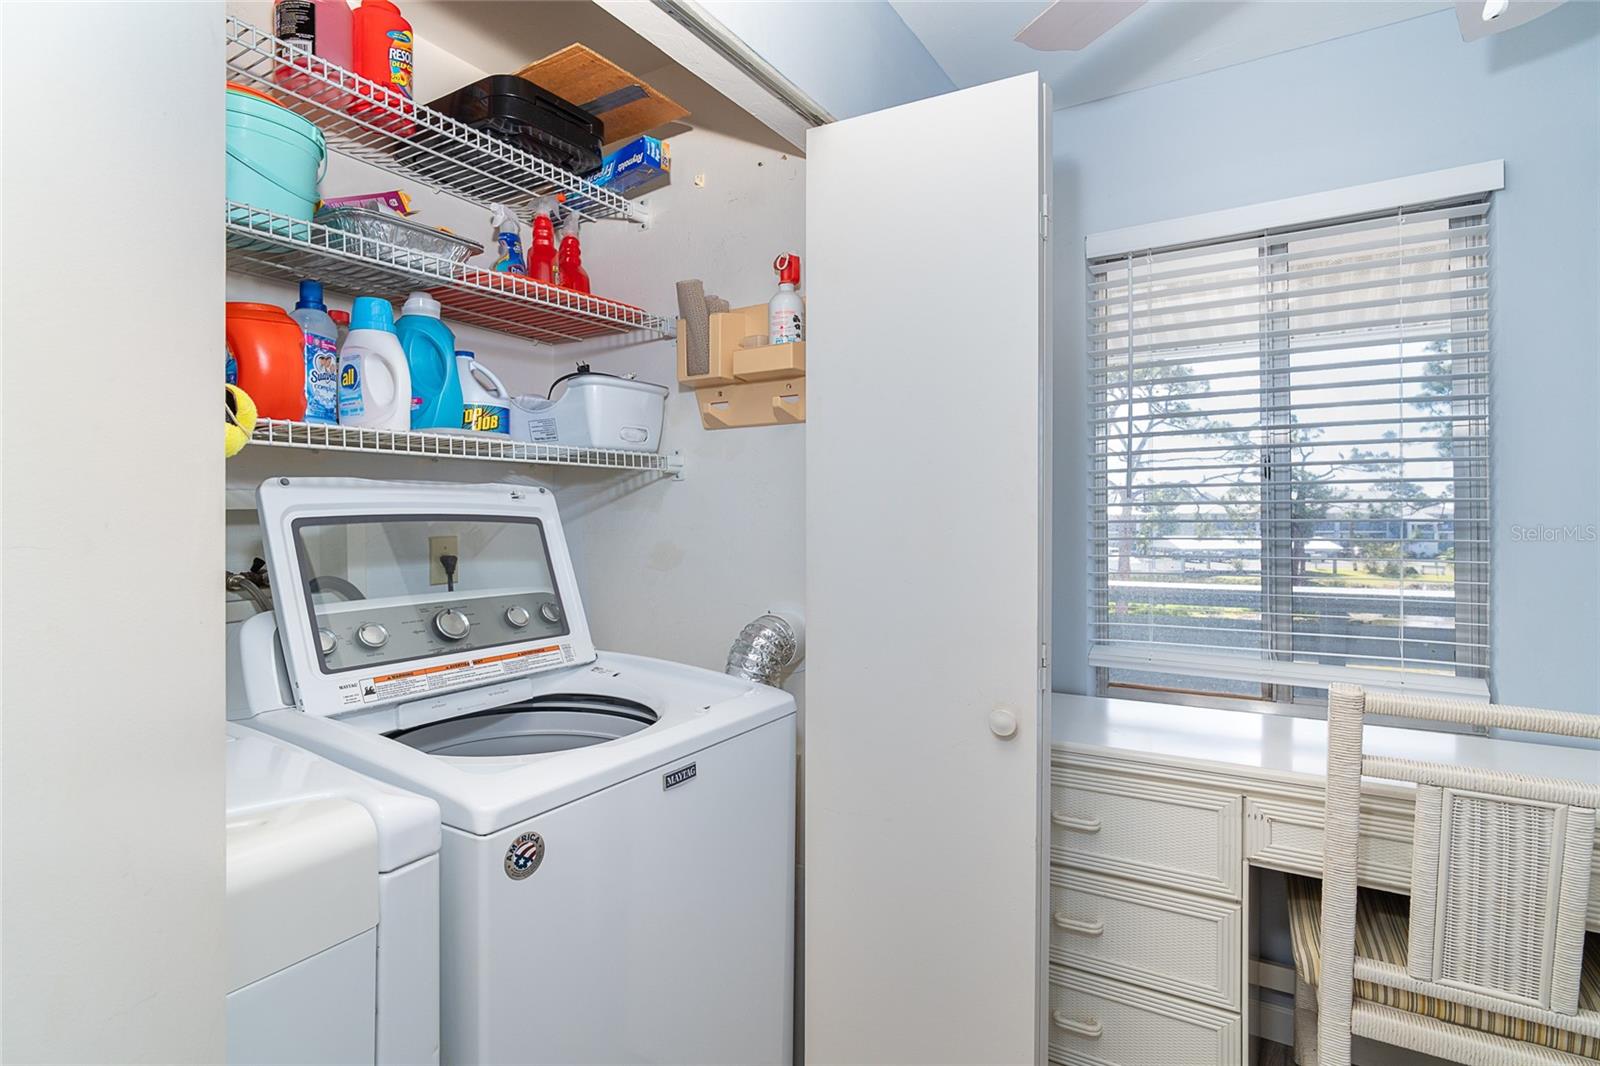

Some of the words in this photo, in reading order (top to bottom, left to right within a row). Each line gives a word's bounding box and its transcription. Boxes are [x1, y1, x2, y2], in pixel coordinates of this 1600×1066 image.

[342, 368, 355, 386] all
[464, 407, 483, 424] OP
[666, 766, 696, 787] MAYTAG
